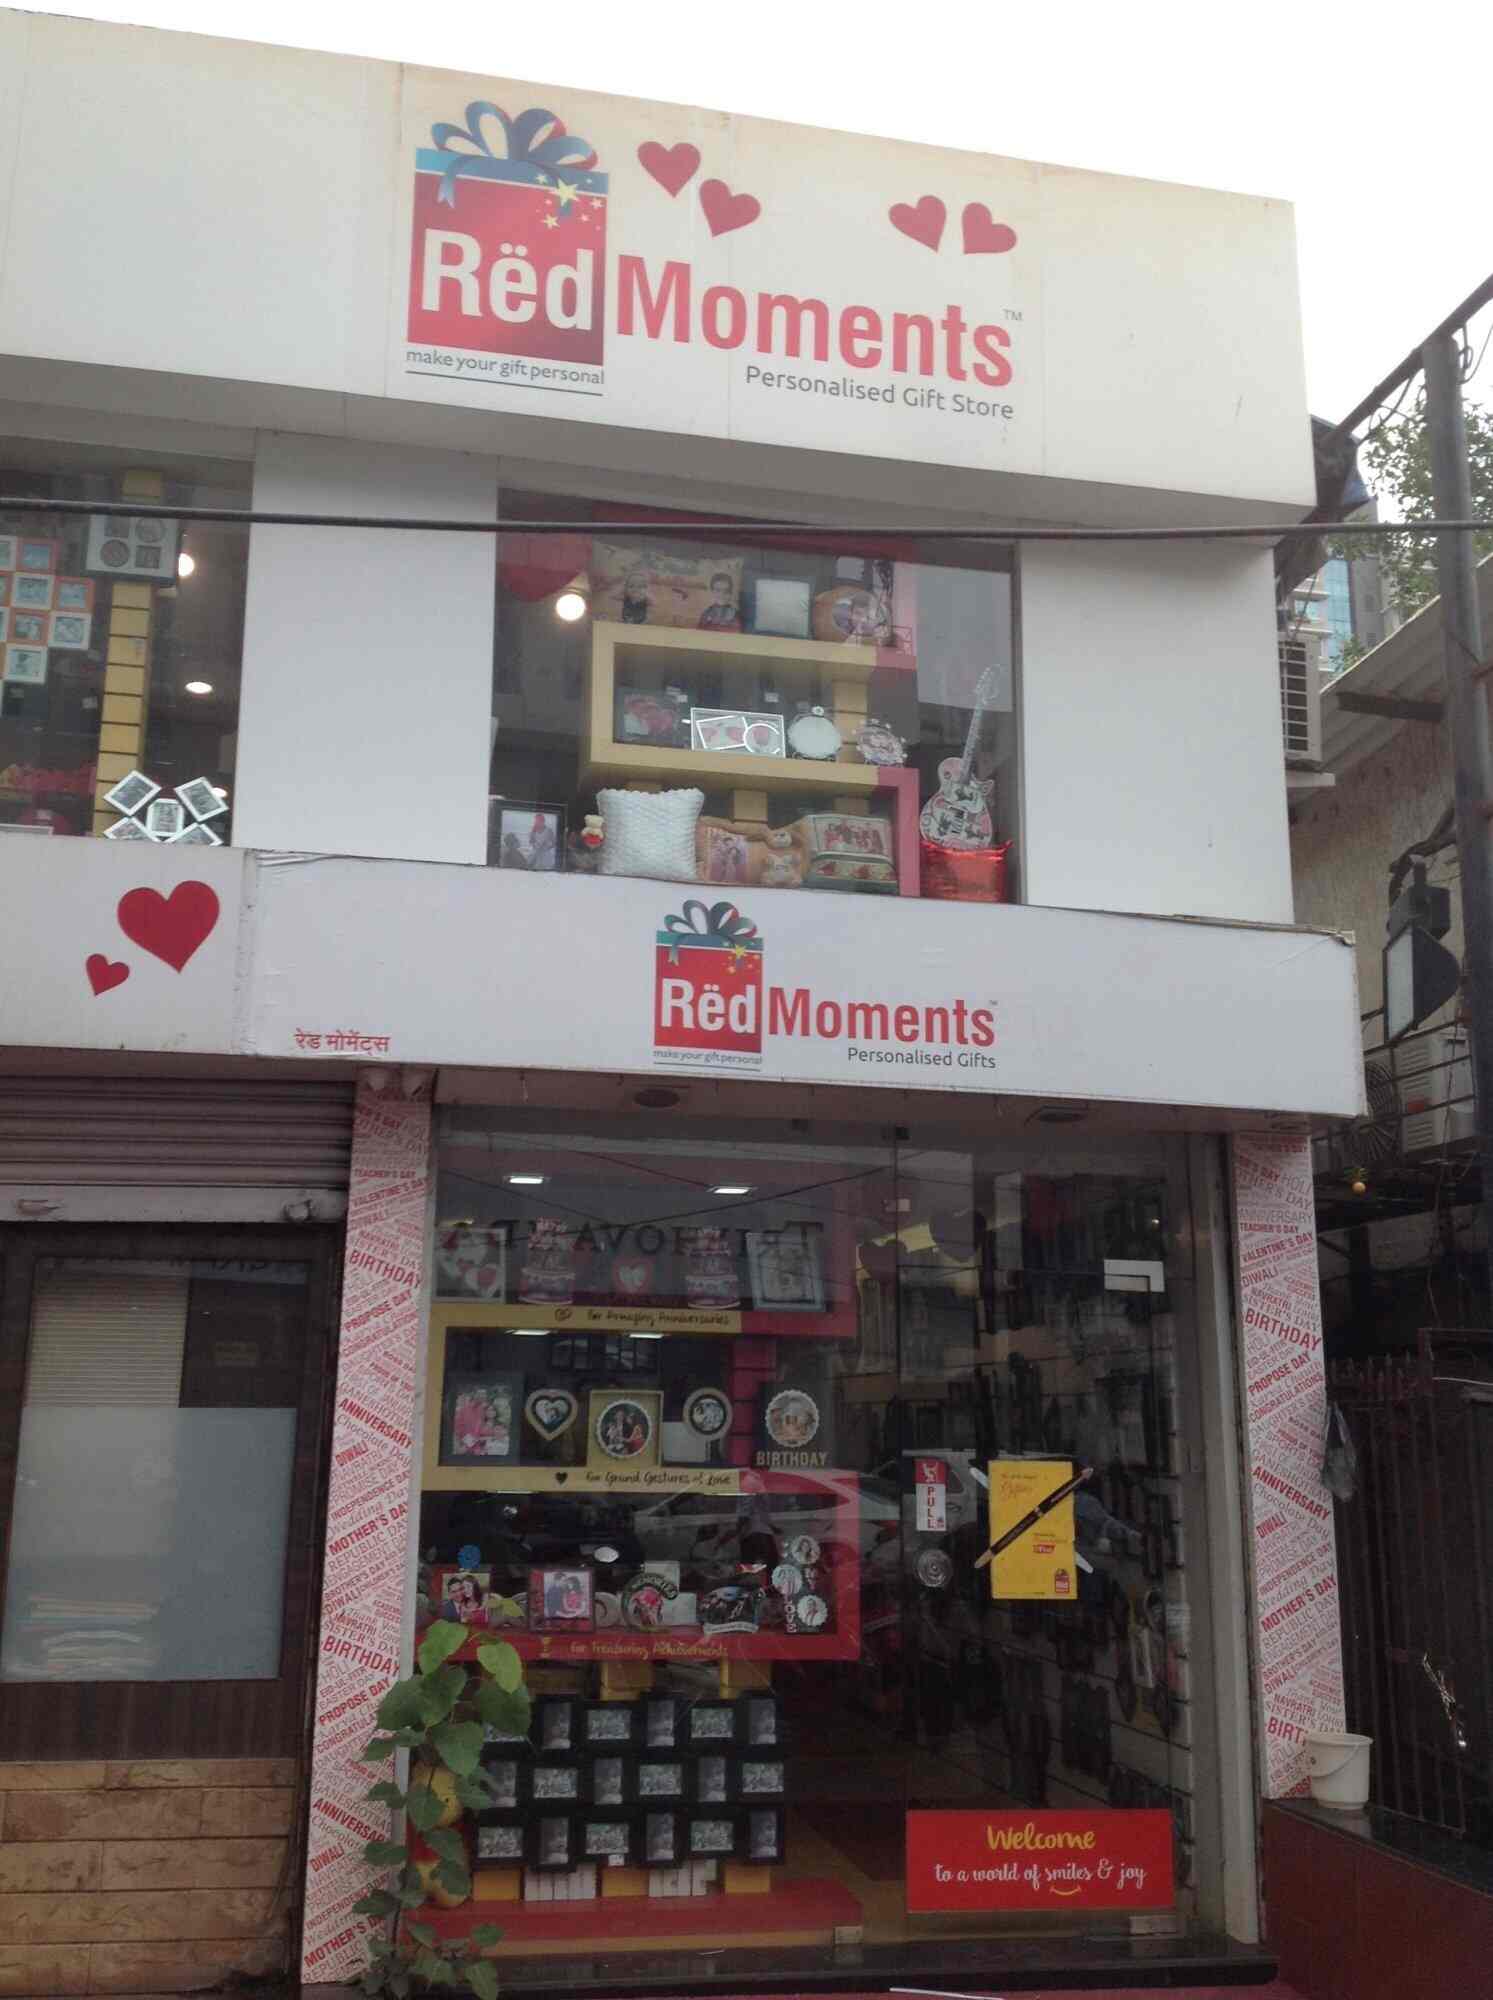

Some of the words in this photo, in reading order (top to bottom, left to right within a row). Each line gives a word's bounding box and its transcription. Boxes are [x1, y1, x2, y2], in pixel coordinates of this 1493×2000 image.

[421, 228, 594, 330] Rëd
[616, 253, 1013, 387] Moments
[406, 349, 453, 366] make
[456, 356, 498, 371] your
[500, 360, 527, 377] gift
[530, 366, 605, 385] personal
[746, 365, 895, 404] Personalised
[903, 387, 946, 411] Gift
[952, 394, 1014, 419] Store
[768, 986, 995, 1047] Moments
[294, 1027, 322, 1049] रेड
[325, 1028, 391, 1056] मोमेंट्स
[653, 1050, 679, 1058] make
[680, 1052, 704, 1060] your
[847, 1046, 953, 1067] Personalised
[958, 1051, 996, 1069] Gifts
[1295, 1231, 1313, 1246] DAY
[348, 1249, 421, 1289] BIRTHDAY
[1241, 1264, 1279, 1288] DIWALI
[1245, 1307, 1322, 1351] BIRTHDAY
[1248, 1362, 1291, 1397] PROPOSE
[1290, 1350, 1310, 1370] DAY
[338, 1397, 412, 1449] ANNIVERSARY
[335, 1440, 369, 1467] DIWALI
[756, 1451, 828, 1466] BIRTHDAY
[1252, 1464, 1330, 1521] ANNIVERSARY
[329, 1513, 389, 1557] MOTHER'S
[1256, 1510, 1288, 1539] DIWALI
[1261, 1588, 1315, 1633] MOTHER'S
[1314, 1573, 1337, 1597] DAY
[322, 1634, 400, 1678] BIRTHDAY
[319, 1690, 369, 1726] PROPOSE
[369, 1677, 390, 1697] DAY
[310, 1842, 345, 1873] DIWALI
[986, 1822, 1096, 1851] Welcome
[935, 1863, 953, 1882] to
[957, 1871, 970, 1882] a
[973, 1863, 1021, 1882] world
[1024, 1863, 1041, 1890] of
[1046, 1862, 1094, 1882] smiles
[1097, 1858, 1114, 1880] &
[1118, 1862, 1148, 1890] joy
[303, 1921, 367, 1968] MOTHER'S
